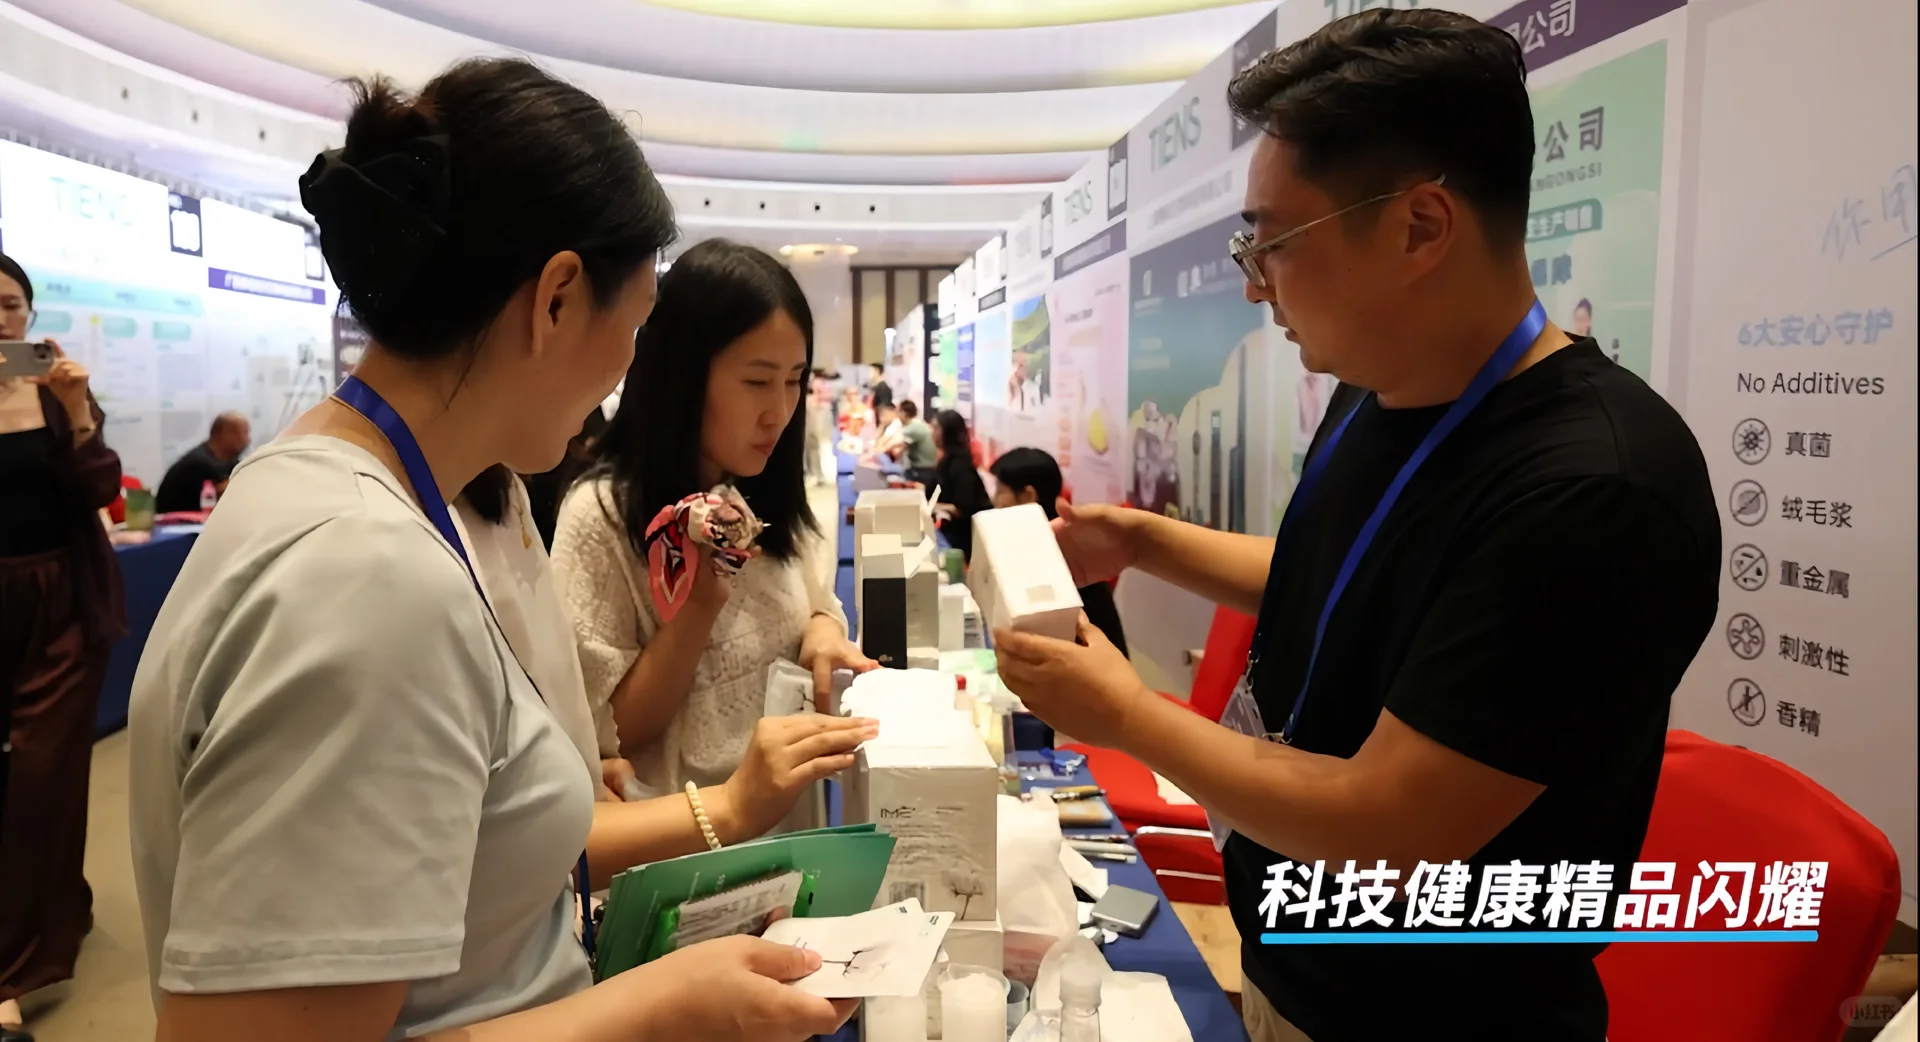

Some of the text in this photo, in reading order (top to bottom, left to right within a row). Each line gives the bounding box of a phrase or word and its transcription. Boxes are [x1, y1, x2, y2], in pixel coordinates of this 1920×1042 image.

[1149, 96, 1202, 173] TIENS
[1543, 106, 1604, 162] 公司
[1738, 307, 1893, 347] 6大安心守护
[1737, 372, 1884, 395] No Additives
[1784, 431, 1832, 458] 真菌
[1779, 559, 1850, 598] 重金属
[1777, 633, 1851, 677] 刺激性
[1776, 700, 1822, 737] 香精
